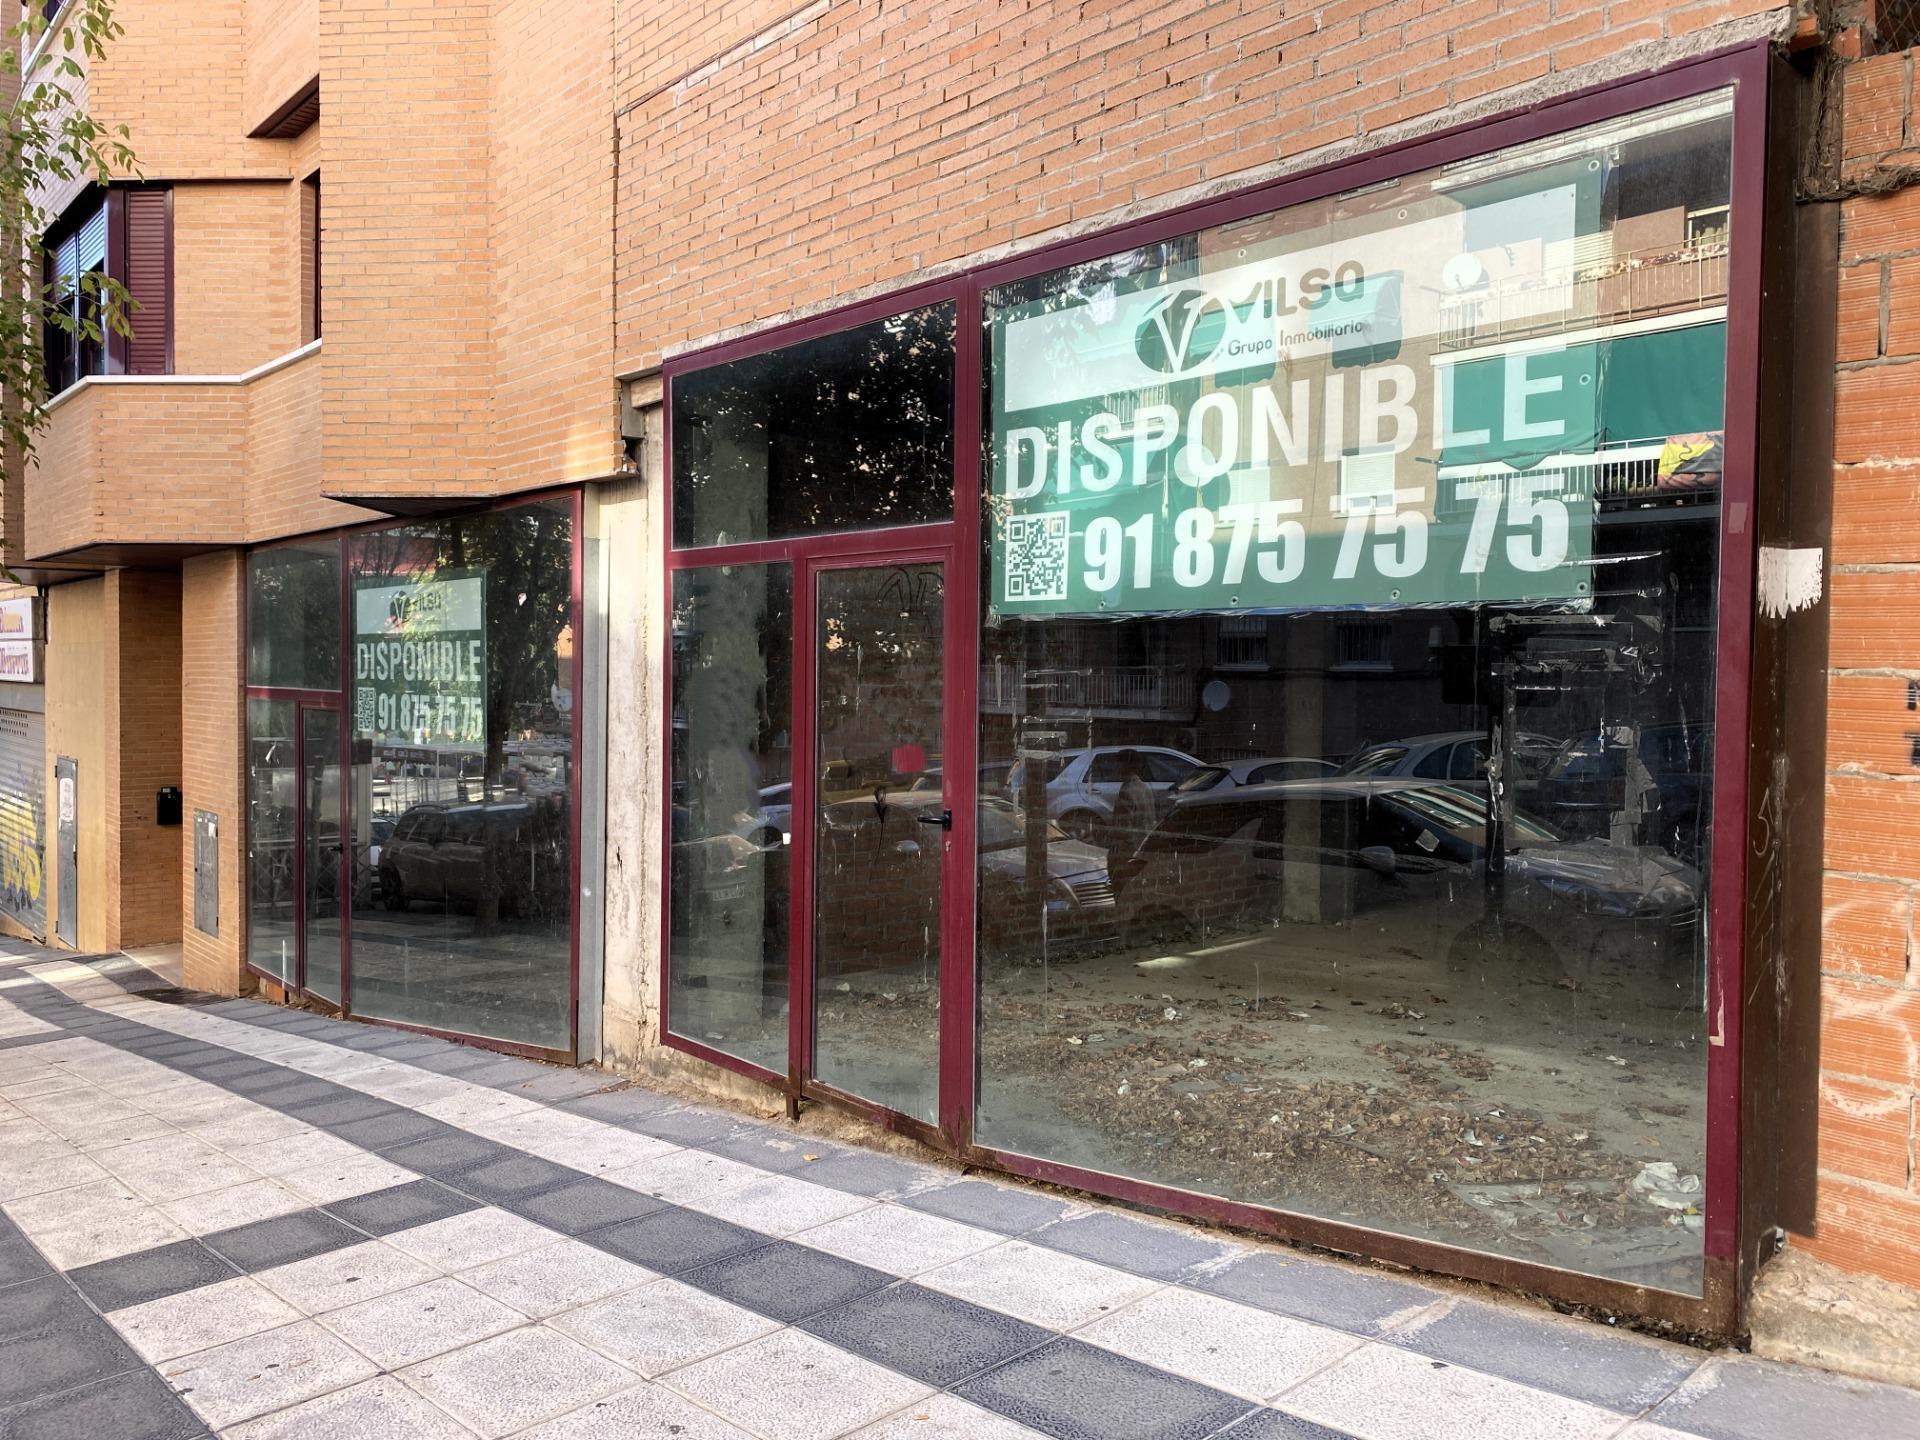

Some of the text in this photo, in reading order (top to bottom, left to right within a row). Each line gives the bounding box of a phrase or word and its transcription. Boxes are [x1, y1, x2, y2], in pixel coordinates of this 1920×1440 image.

[1227, 320, 1364, 358] Grupo Inmobiliario
[1005, 338, 1567, 499] DISPONIBLE
[1083, 473, 1570, 591] 91 875 75 75
[357, 641, 481, 681] DISPONIBLE
[378, 693, 483, 738] 91 875 75 75
